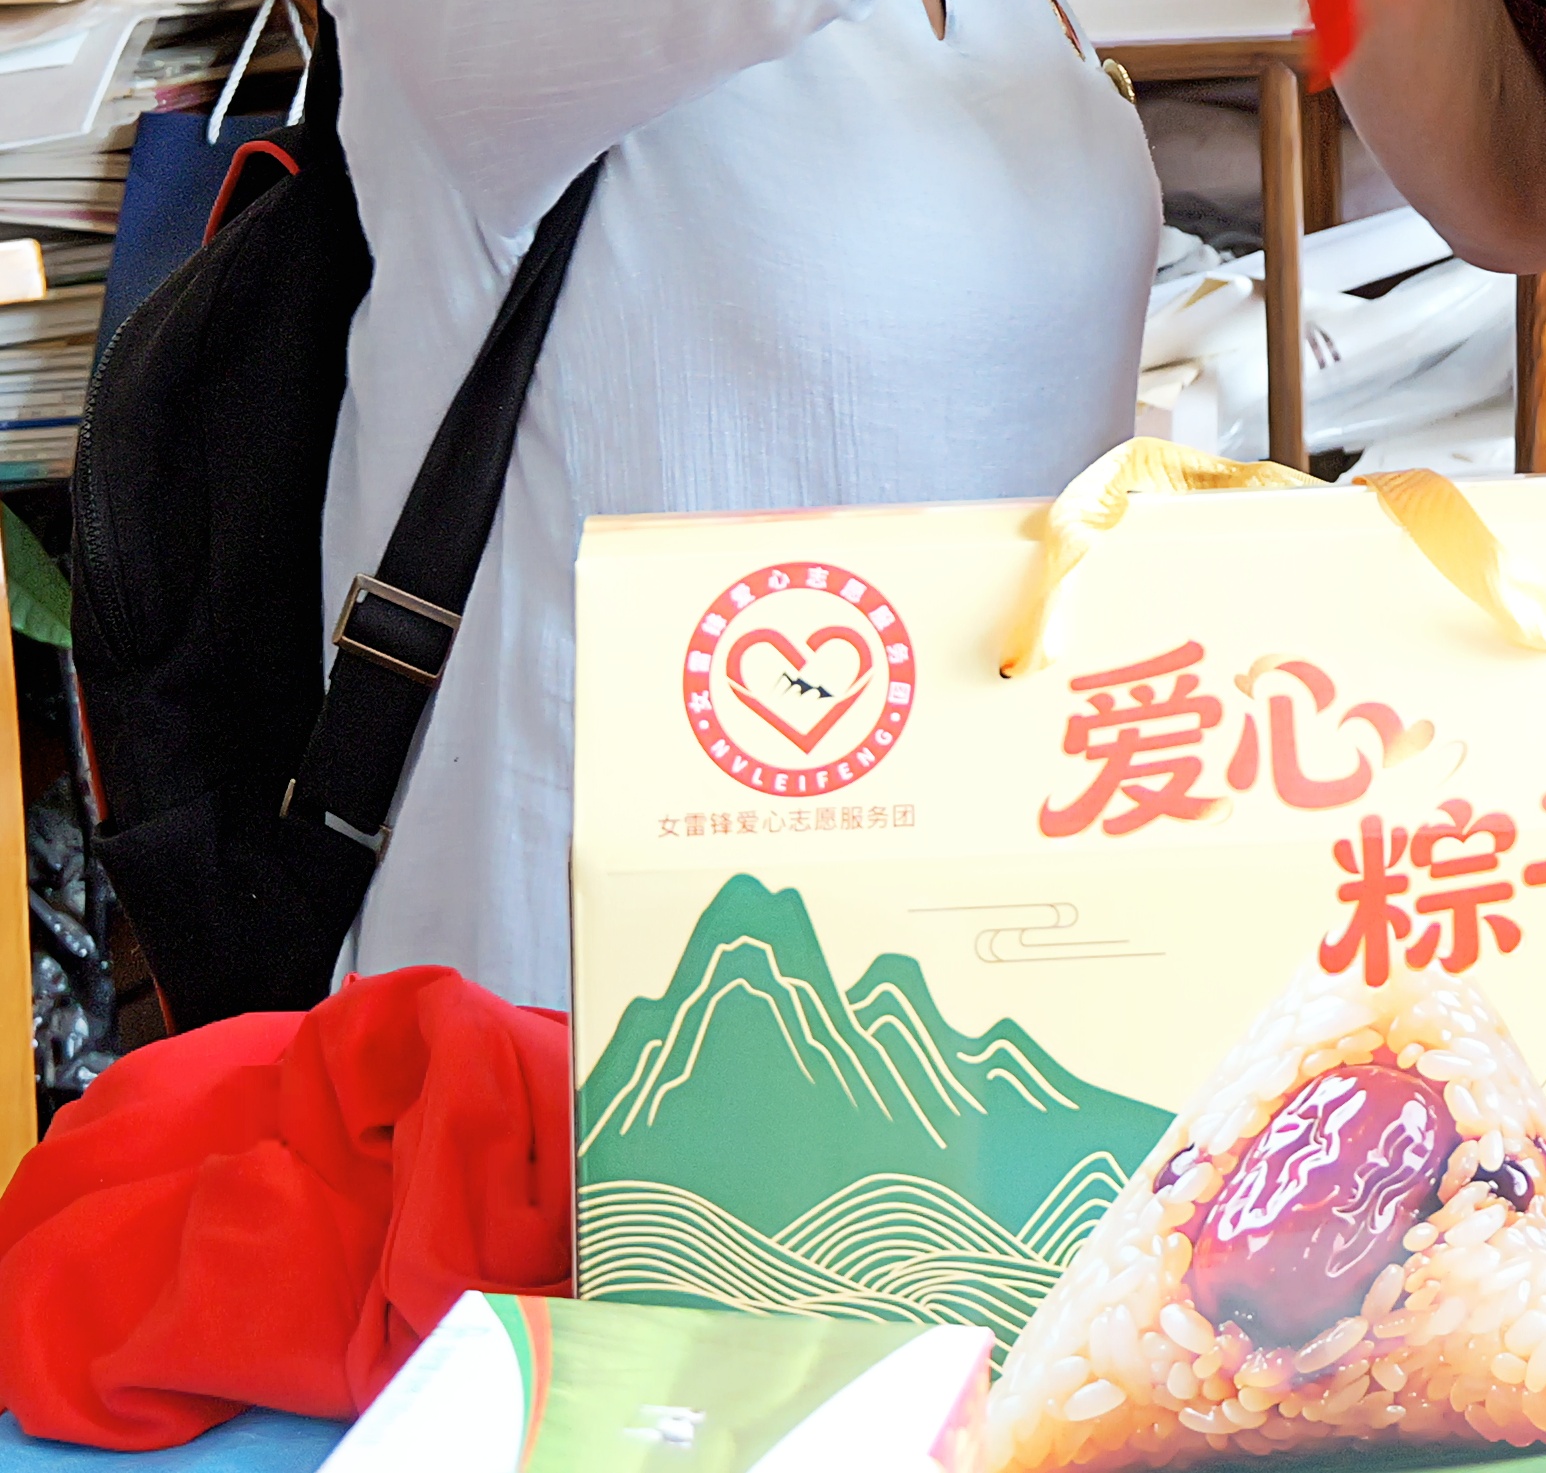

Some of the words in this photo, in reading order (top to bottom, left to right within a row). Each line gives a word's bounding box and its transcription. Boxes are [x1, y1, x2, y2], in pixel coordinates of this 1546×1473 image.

[710, 728, 893, 792] NVLEIFENG
[1038, 639, 1434, 838] 爱心
[658, 803, 916, 838] 女雷锋爱心志愿服务团
